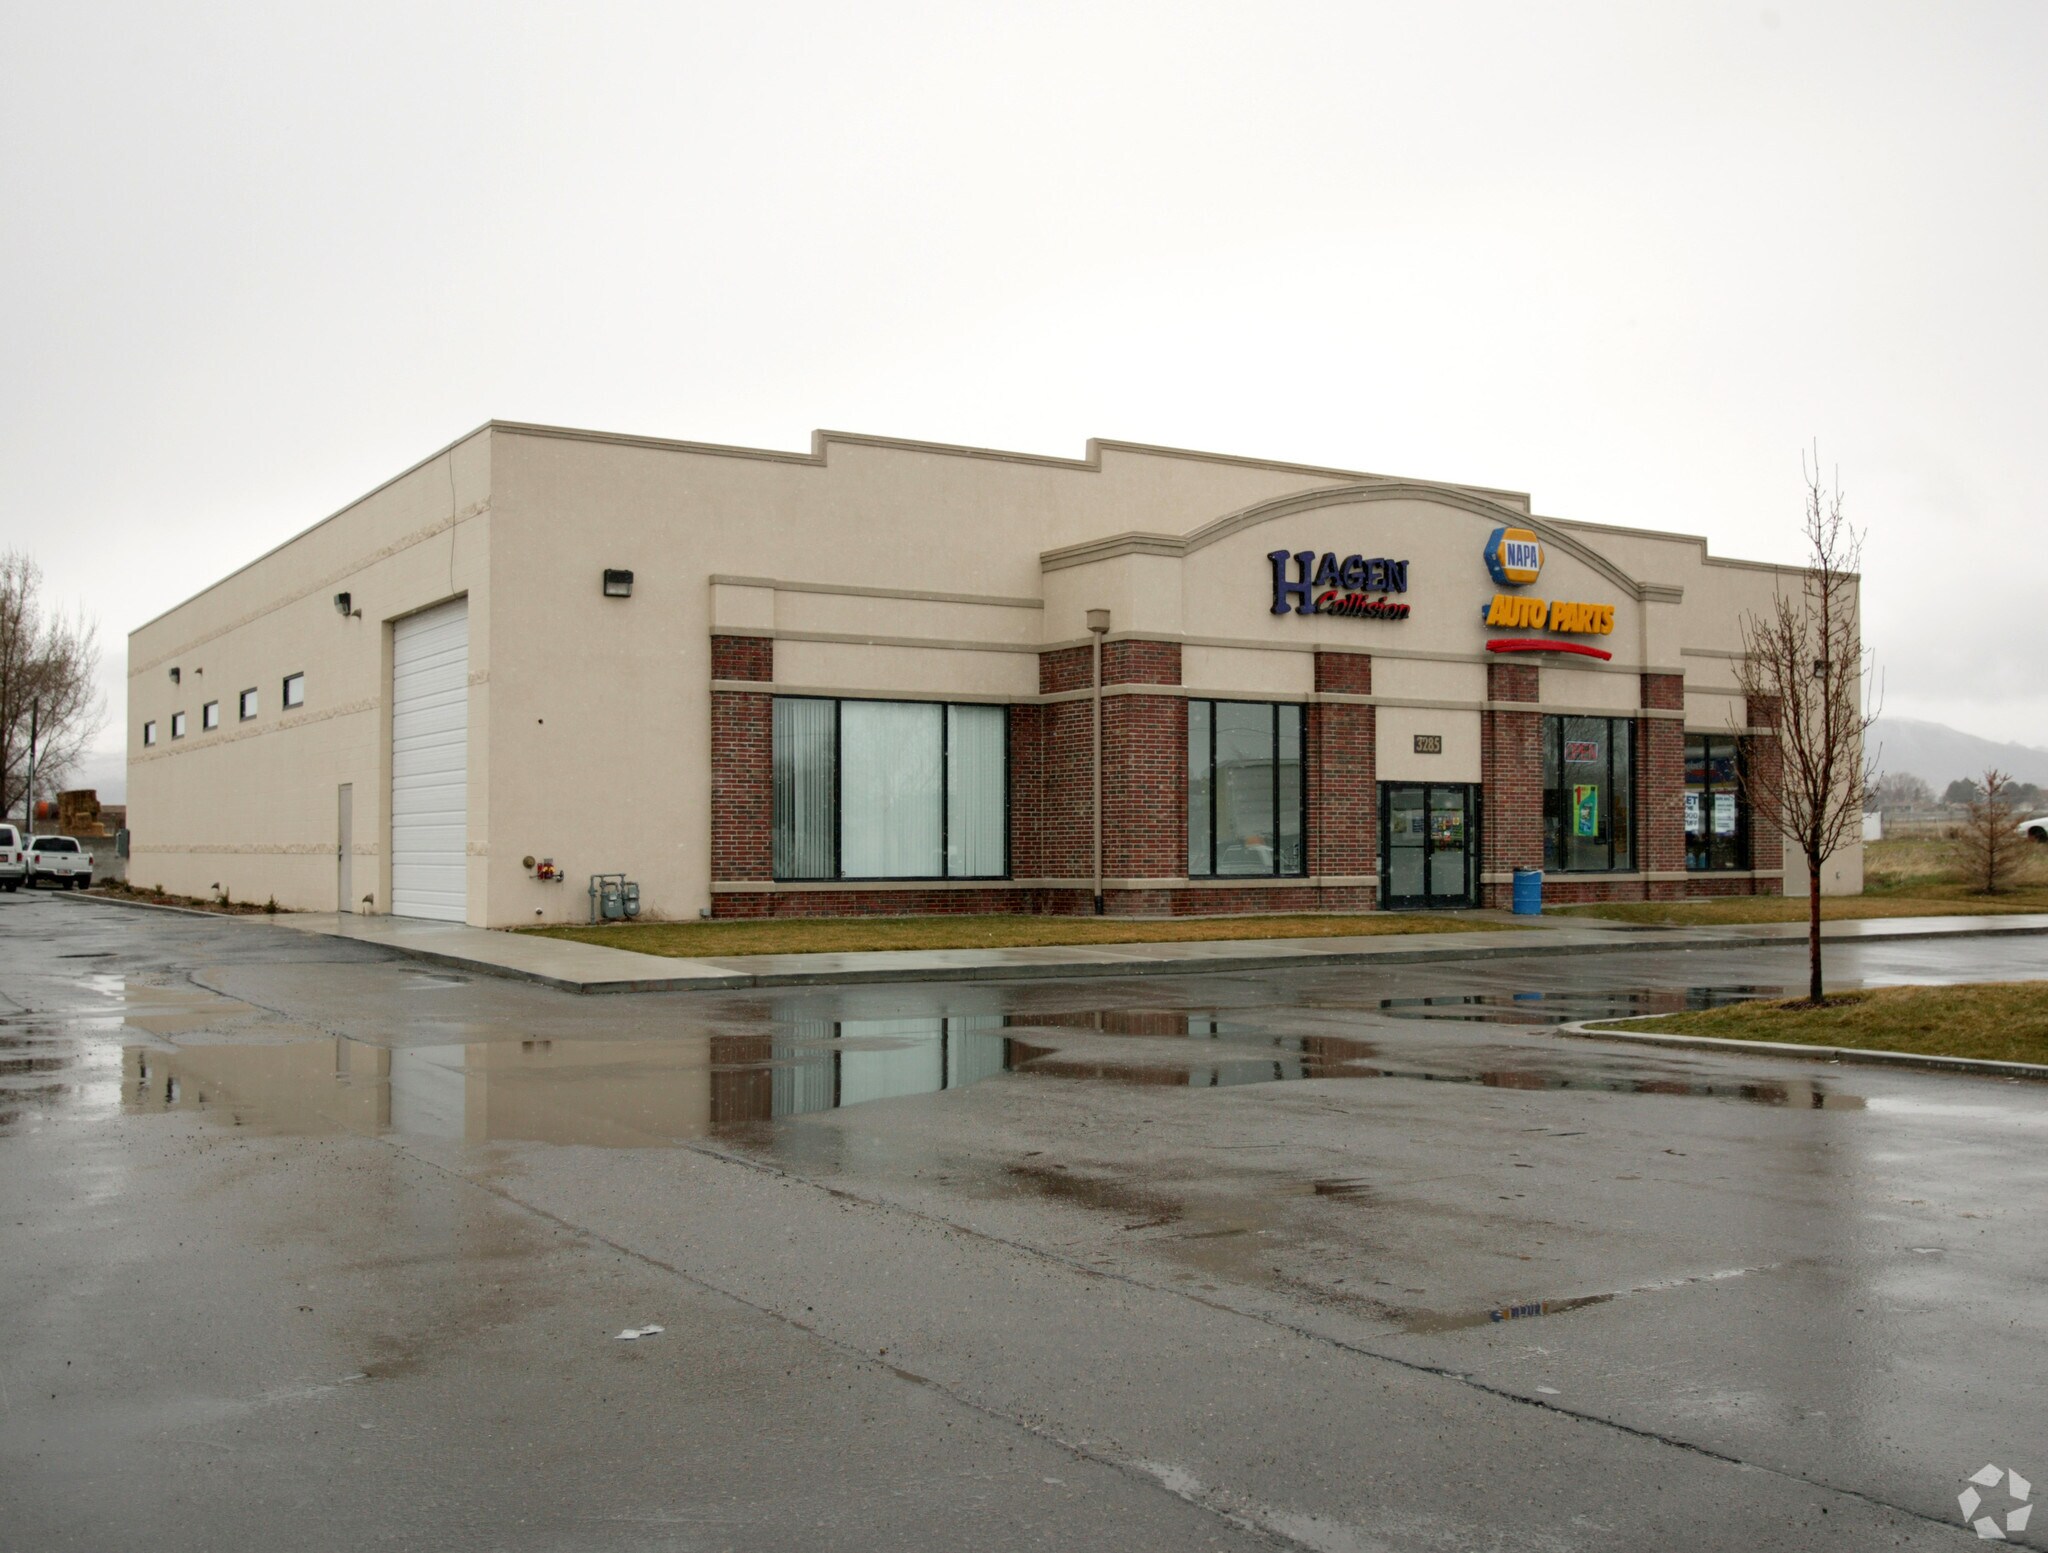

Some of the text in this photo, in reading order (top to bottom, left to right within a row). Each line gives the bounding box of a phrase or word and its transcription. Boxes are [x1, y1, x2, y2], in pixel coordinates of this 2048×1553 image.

[1507, 543, 1537, 568] NAPA
[1267, 550, 1409, 614] HAGEN
[1315, 590, 1410, 619] Collision
[1487, 594, 1614, 635] AUTO PARTS
[1416, 736, 1440, 752] 3285
[1686, 795, 1698, 805] ET
